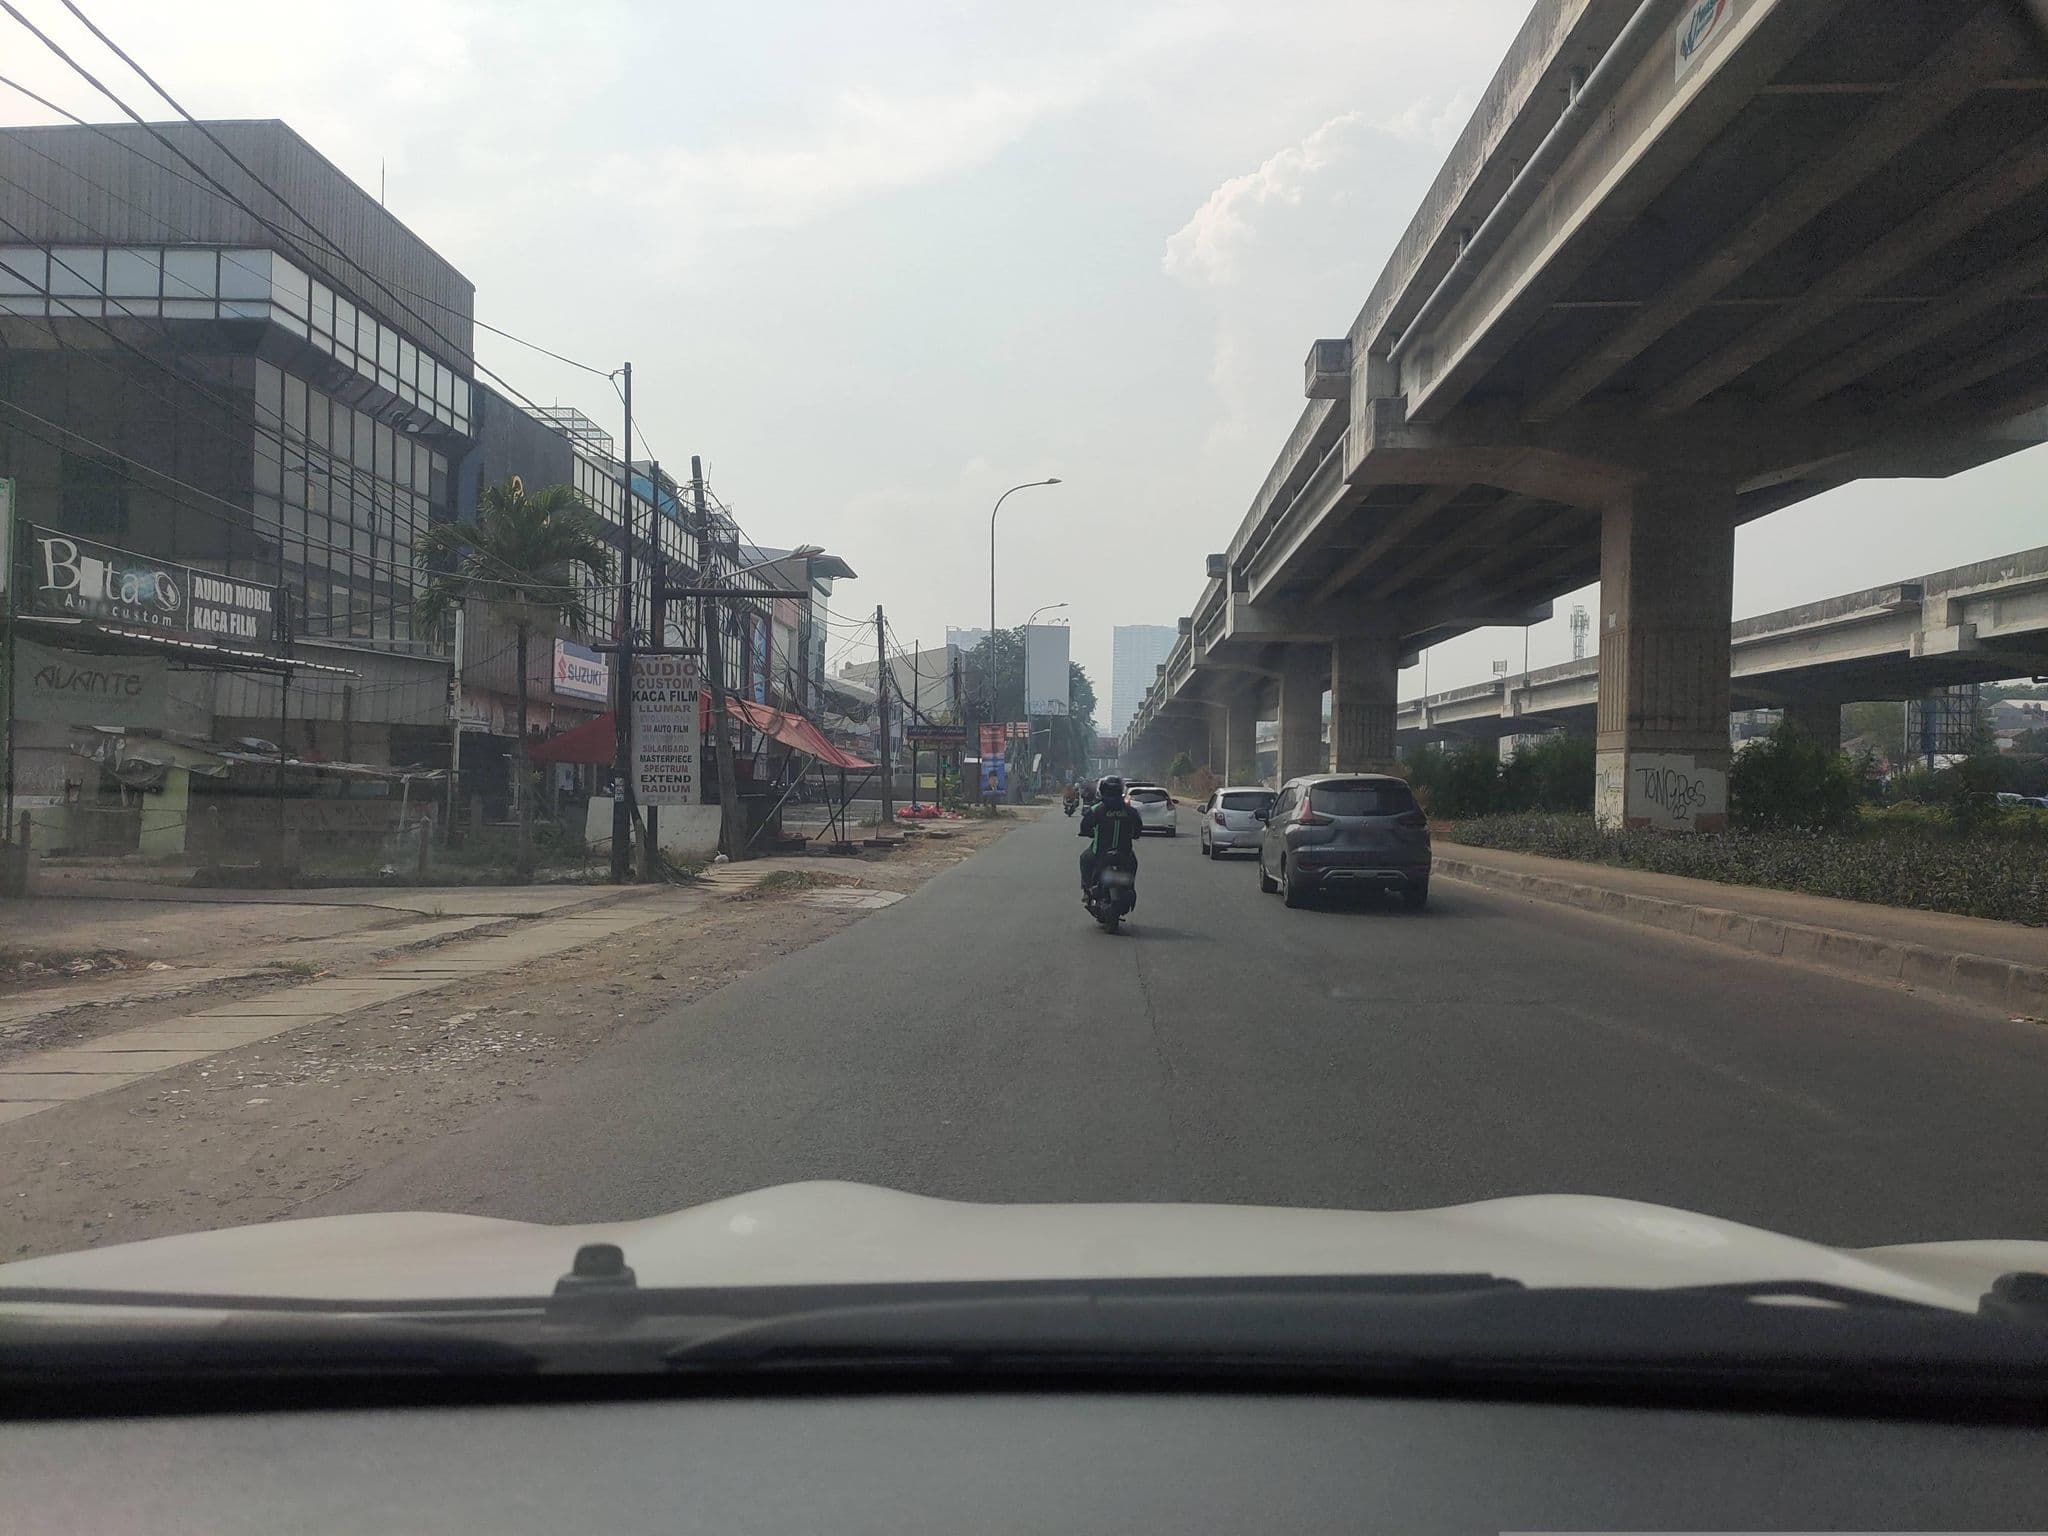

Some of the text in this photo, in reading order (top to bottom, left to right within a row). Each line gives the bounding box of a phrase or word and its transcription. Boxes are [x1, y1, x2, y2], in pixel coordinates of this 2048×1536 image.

[194, 576, 272, 613] AUDIO MOBIL
[112, 605, 172, 627] custom
[193, 606, 257, 638] KACA FILM
[567, 663, 602, 686] SUZUKI
[631, 662, 698, 676] AUDIO
[636, 678, 694, 690] CUSTOM
[631, 690, 698, 702] KACA FILM
[638, 704, 692, 713] LLUMAR
[653, 725, 672, 733] AUTO
[673, 725, 689, 733] FILM
[640, 754, 693, 763] MASTERPIECE
[643, 764, 689, 773] SPECTRUM
[640, 774, 692, 783] EXTEND
[641, 784, 691, 793] RADIUM
